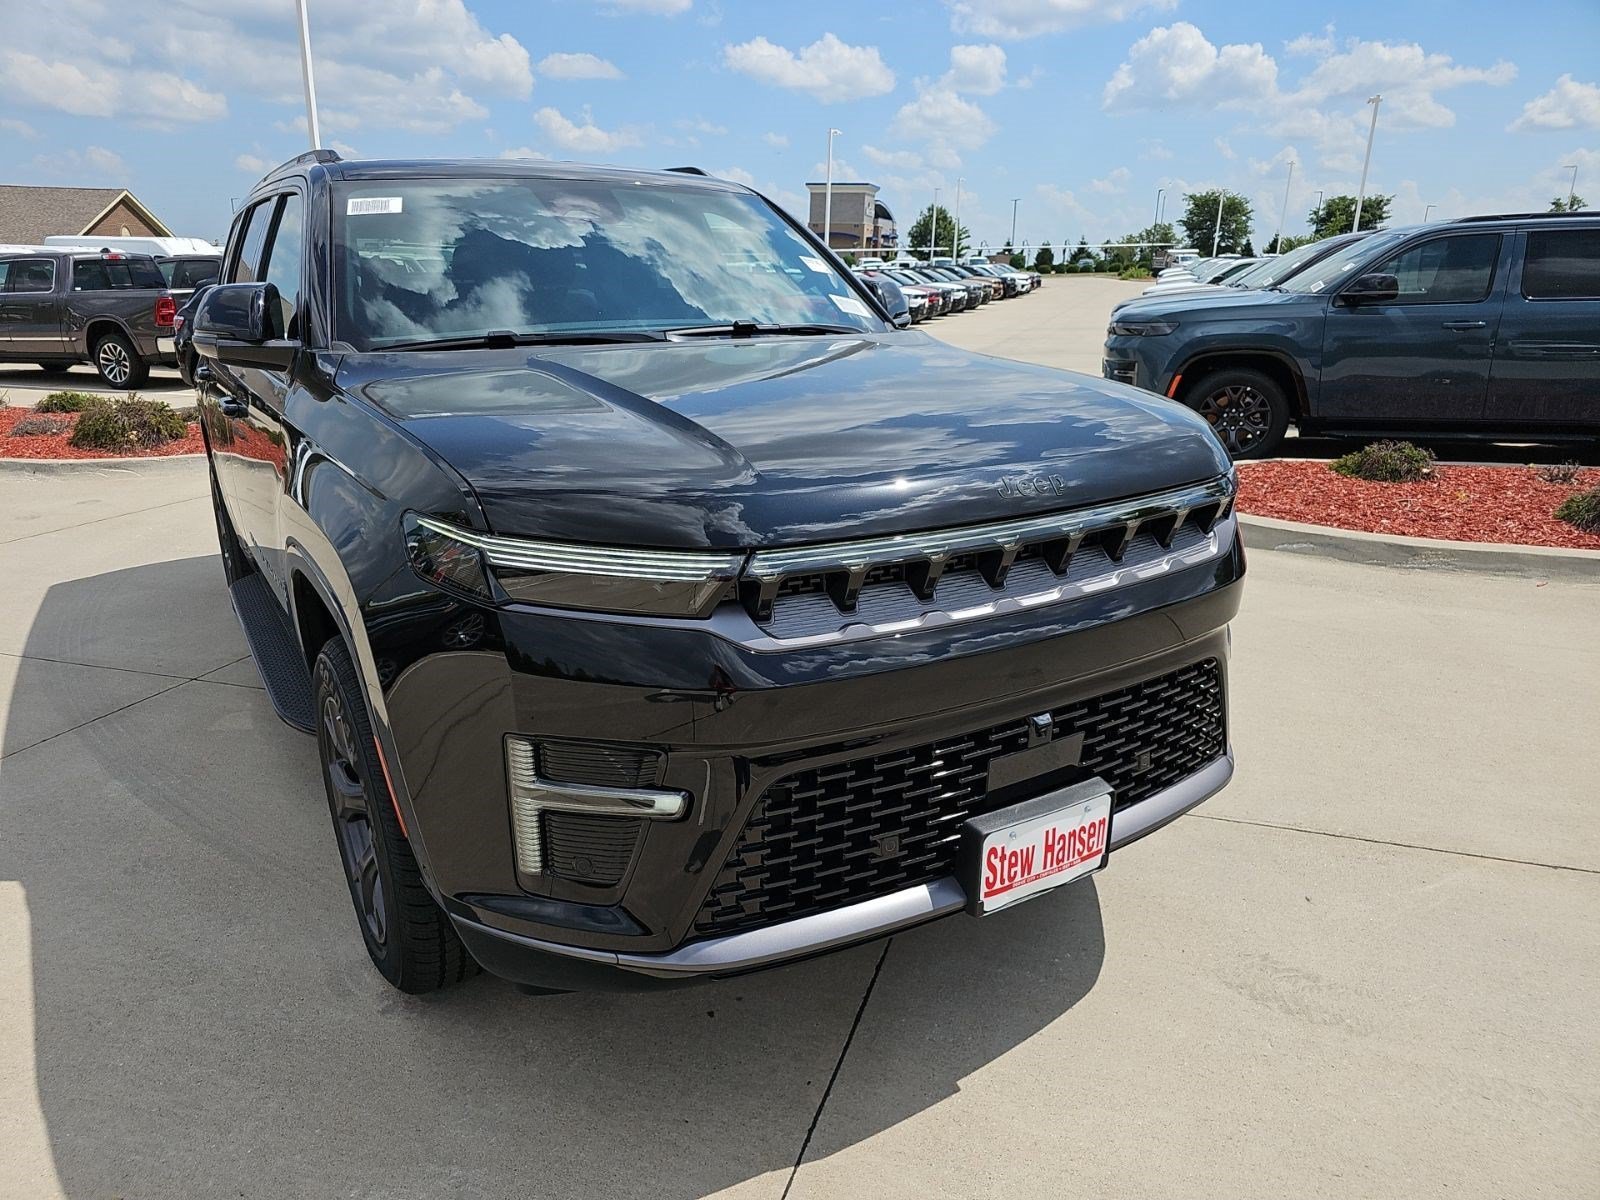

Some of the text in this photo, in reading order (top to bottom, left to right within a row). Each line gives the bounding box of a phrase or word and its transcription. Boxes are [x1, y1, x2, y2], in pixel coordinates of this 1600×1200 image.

[997, 474, 1065, 499] Jeep
[985, 817, 1106, 890] Stew Hansen
